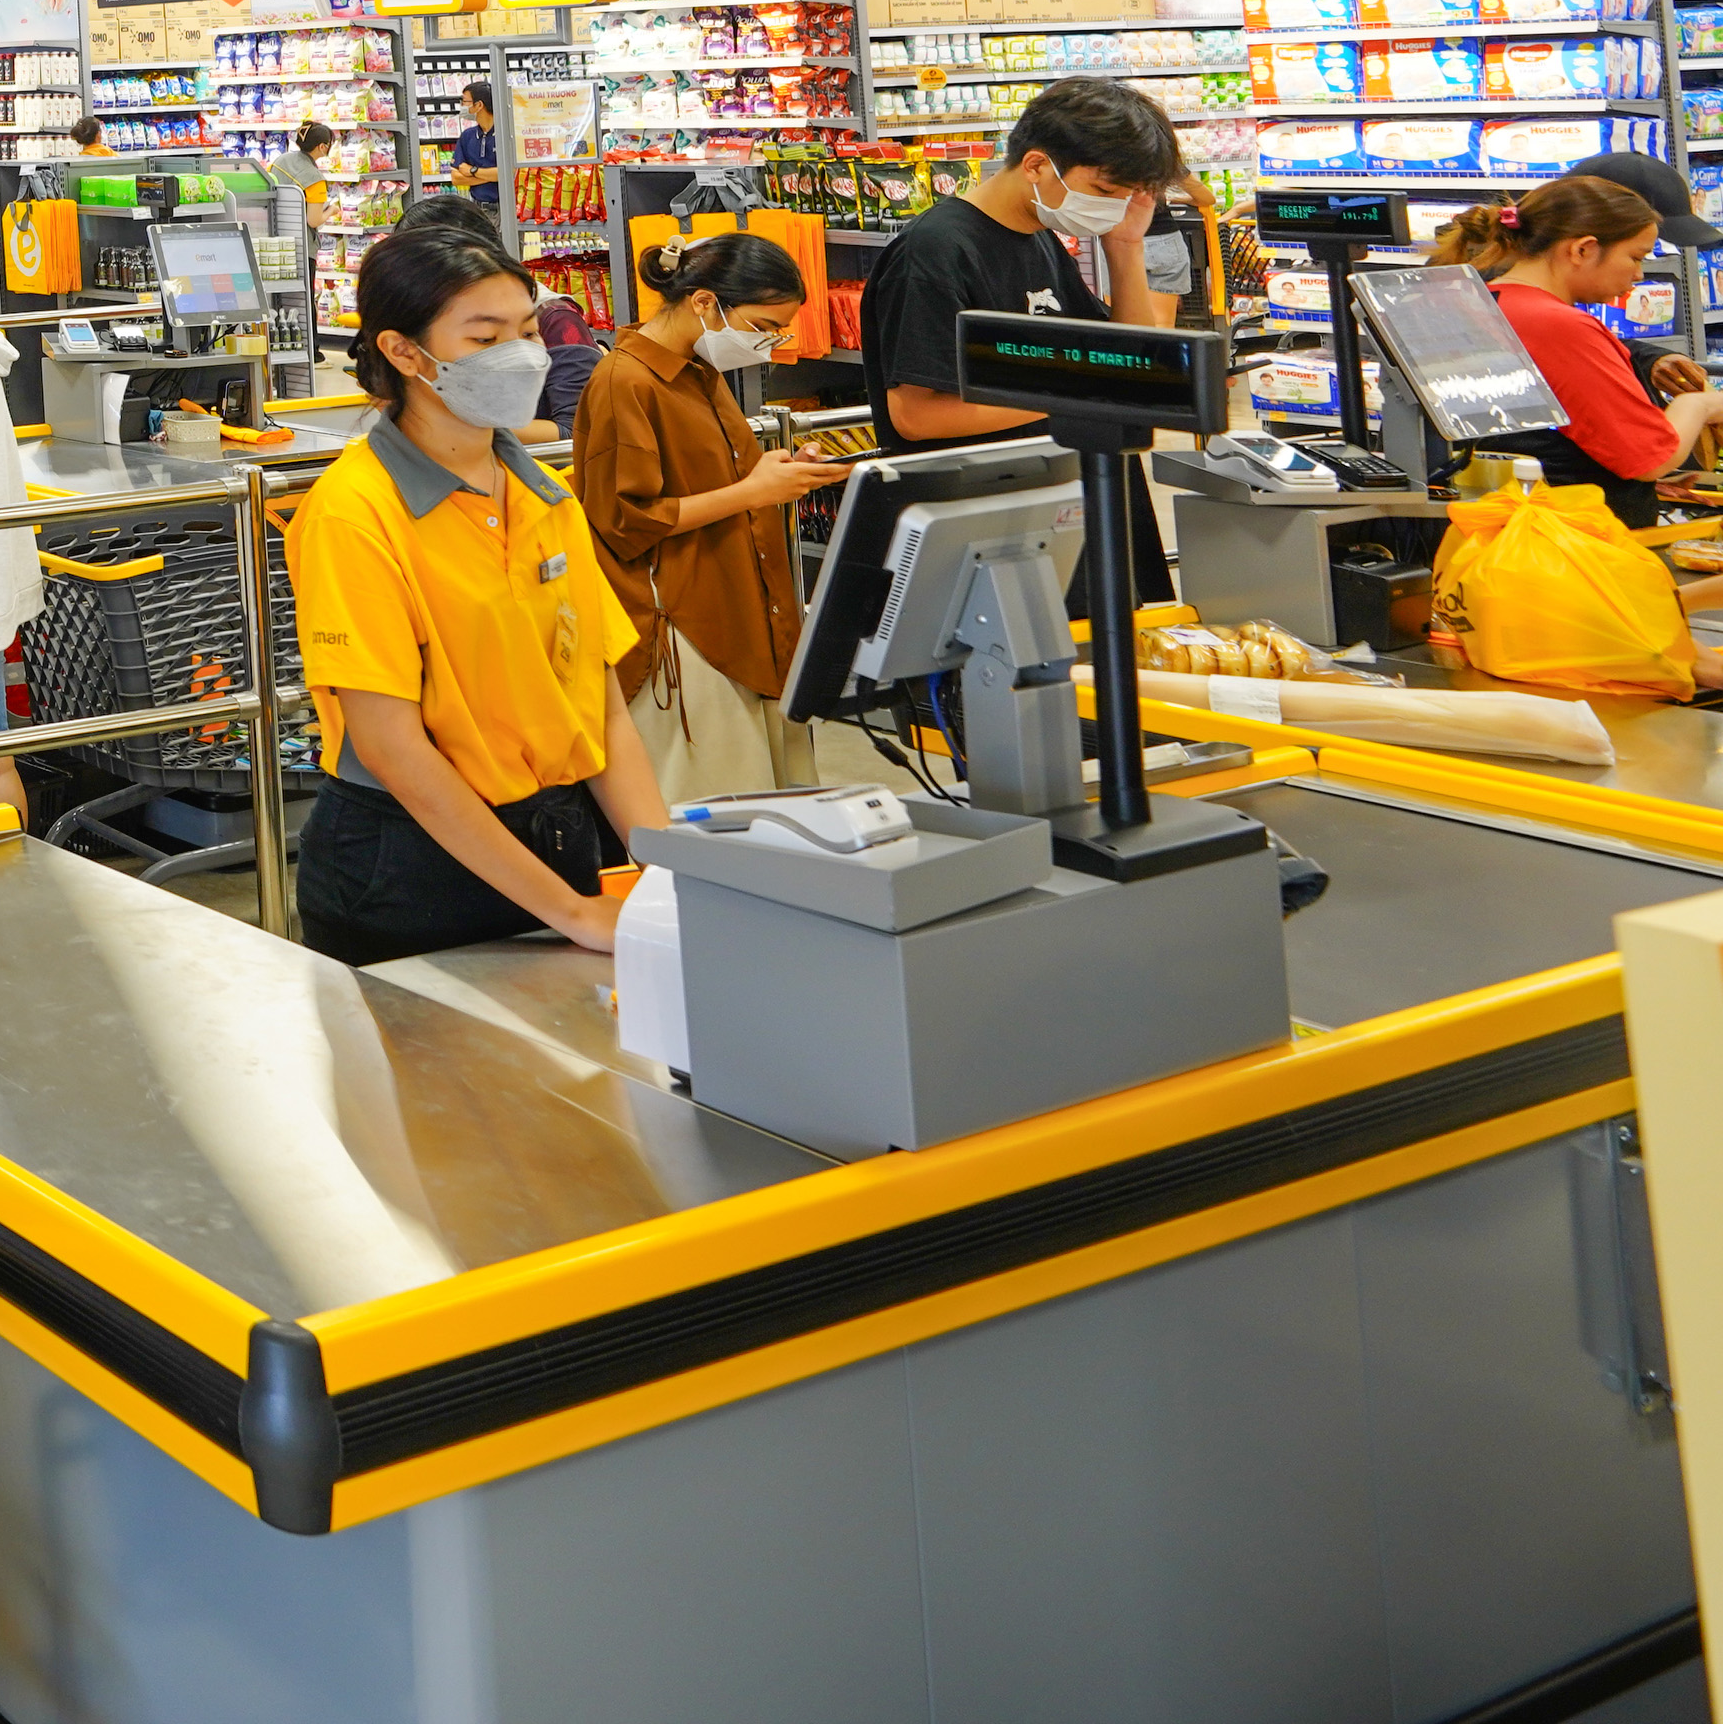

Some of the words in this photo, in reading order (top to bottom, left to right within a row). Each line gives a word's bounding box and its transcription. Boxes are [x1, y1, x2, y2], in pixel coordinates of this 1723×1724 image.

[138, 32, 155, 42] OMO
[185, 30, 200, 40] OMO
[1297, 125, 1339, 134] HUGGIES
[1405, 125, 1452, 134] HUGGIES
[1530, 125, 1580, 135] HUGGIES
[996, 342, 1055, 360] WELCOME
[1064, 349, 1082, 362] TO
[1089, 351, 1151, 370] EMART!!
[1276, 369, 1318, 380] HUGGIES
